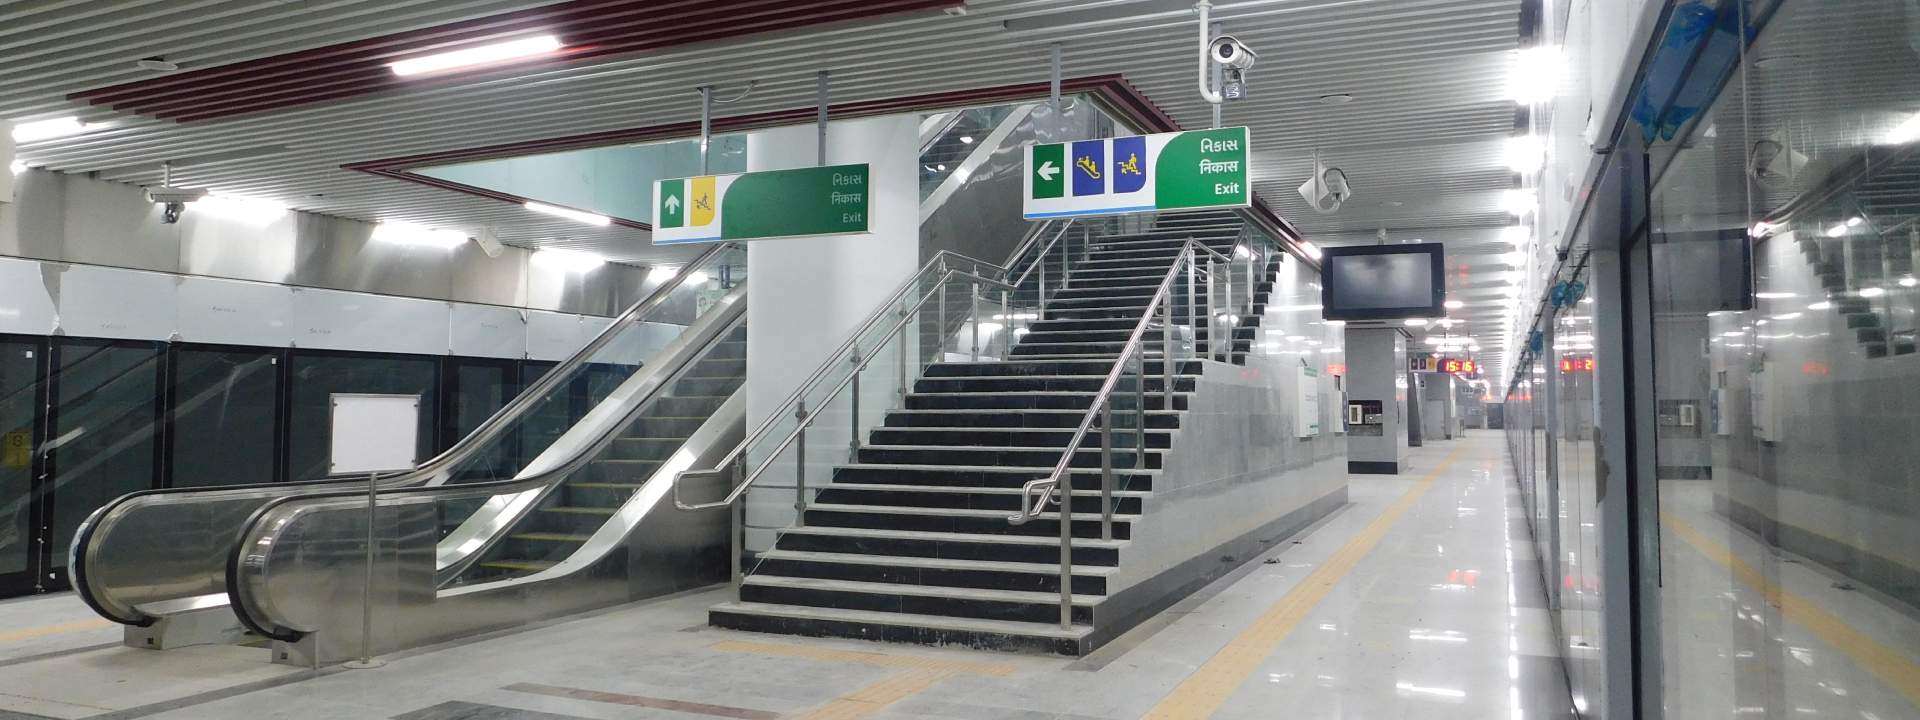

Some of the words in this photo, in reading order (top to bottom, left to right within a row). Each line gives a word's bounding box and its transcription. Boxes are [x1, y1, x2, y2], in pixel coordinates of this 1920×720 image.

[1201, 138, 1239, 153] નિકાસ
[1199, 159, 1239, 174] निकास
[833, 172, 862, 186] નિકાસ
[1215, 182, 1239, 195] Exit
[831, 191, 862, 205] निकास
[842, 212, 862, 223] Exit
